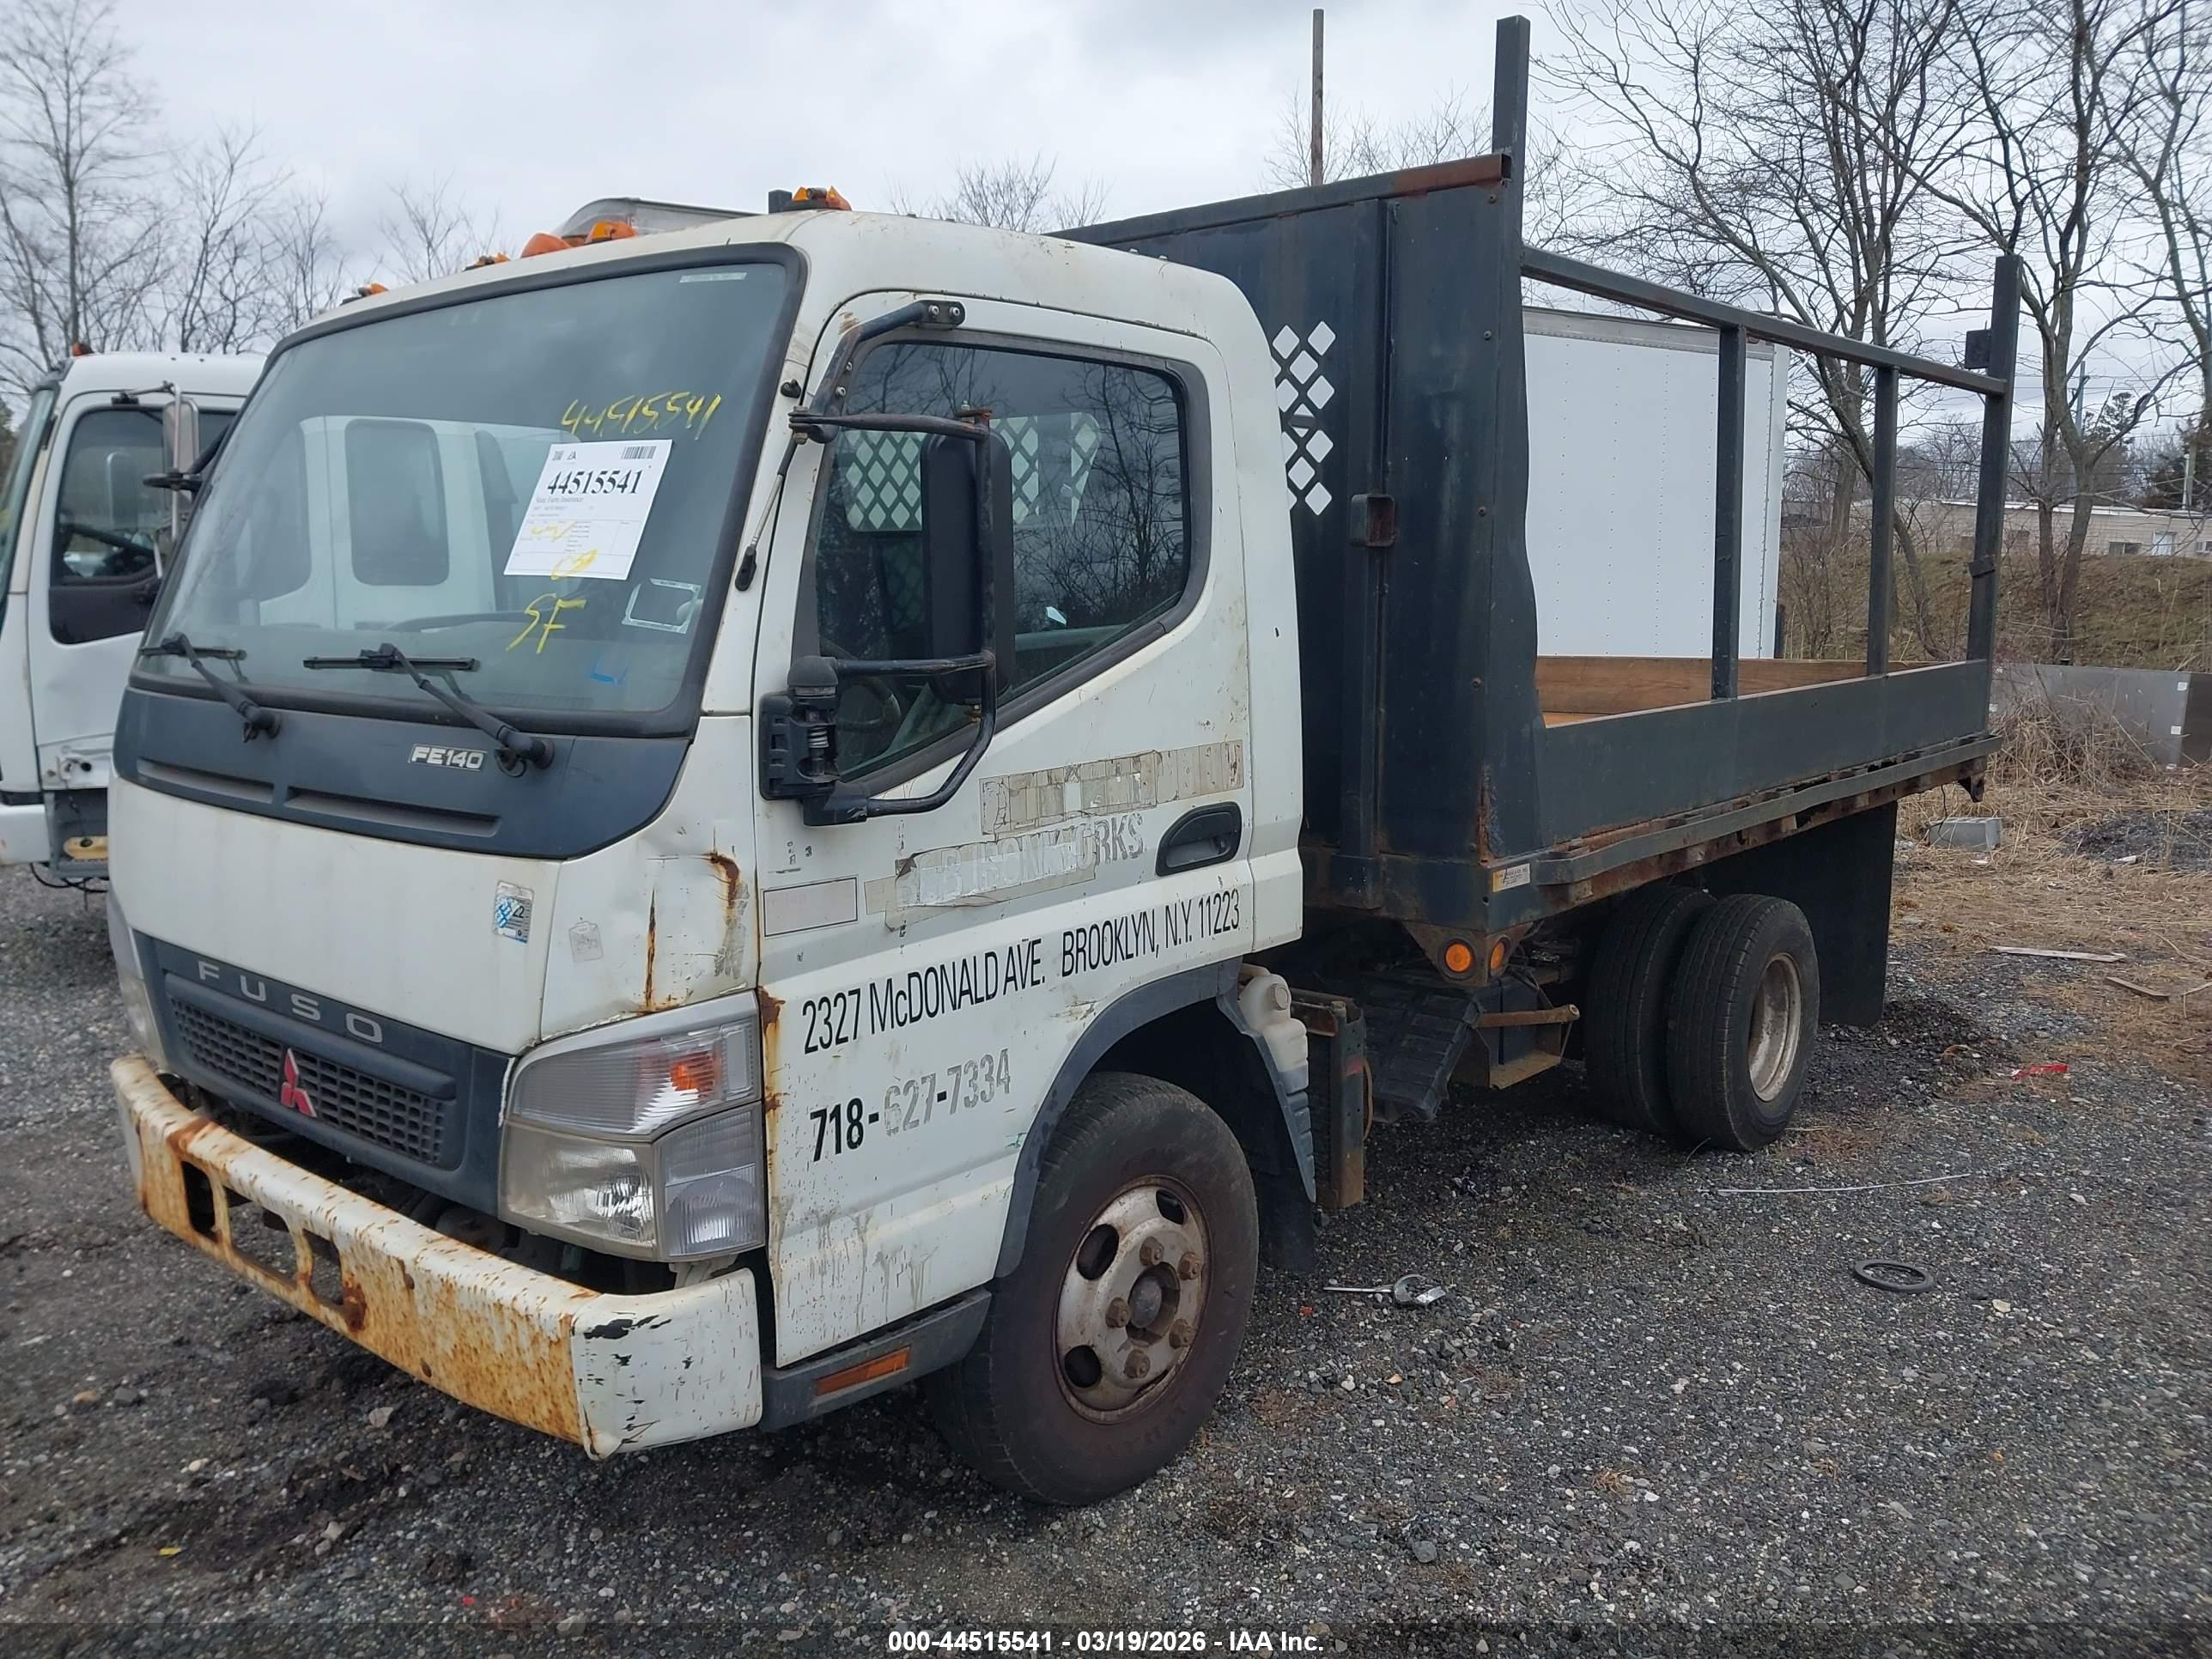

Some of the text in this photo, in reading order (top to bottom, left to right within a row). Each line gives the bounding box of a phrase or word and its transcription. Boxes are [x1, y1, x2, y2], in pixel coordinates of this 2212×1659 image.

[561, 392, 721, 440] 44515541
[547, 469, 643, 495] 44515541
[411, 746, 484, 769] FE140
[198, 960, 383, 1043] FUSO
[802, 889, 1240, 1054] 2327 McDONALD AVE. BROOKLYN, N.Y. 11223
[810, 1048, 1011, 1162] 718-627-7334
